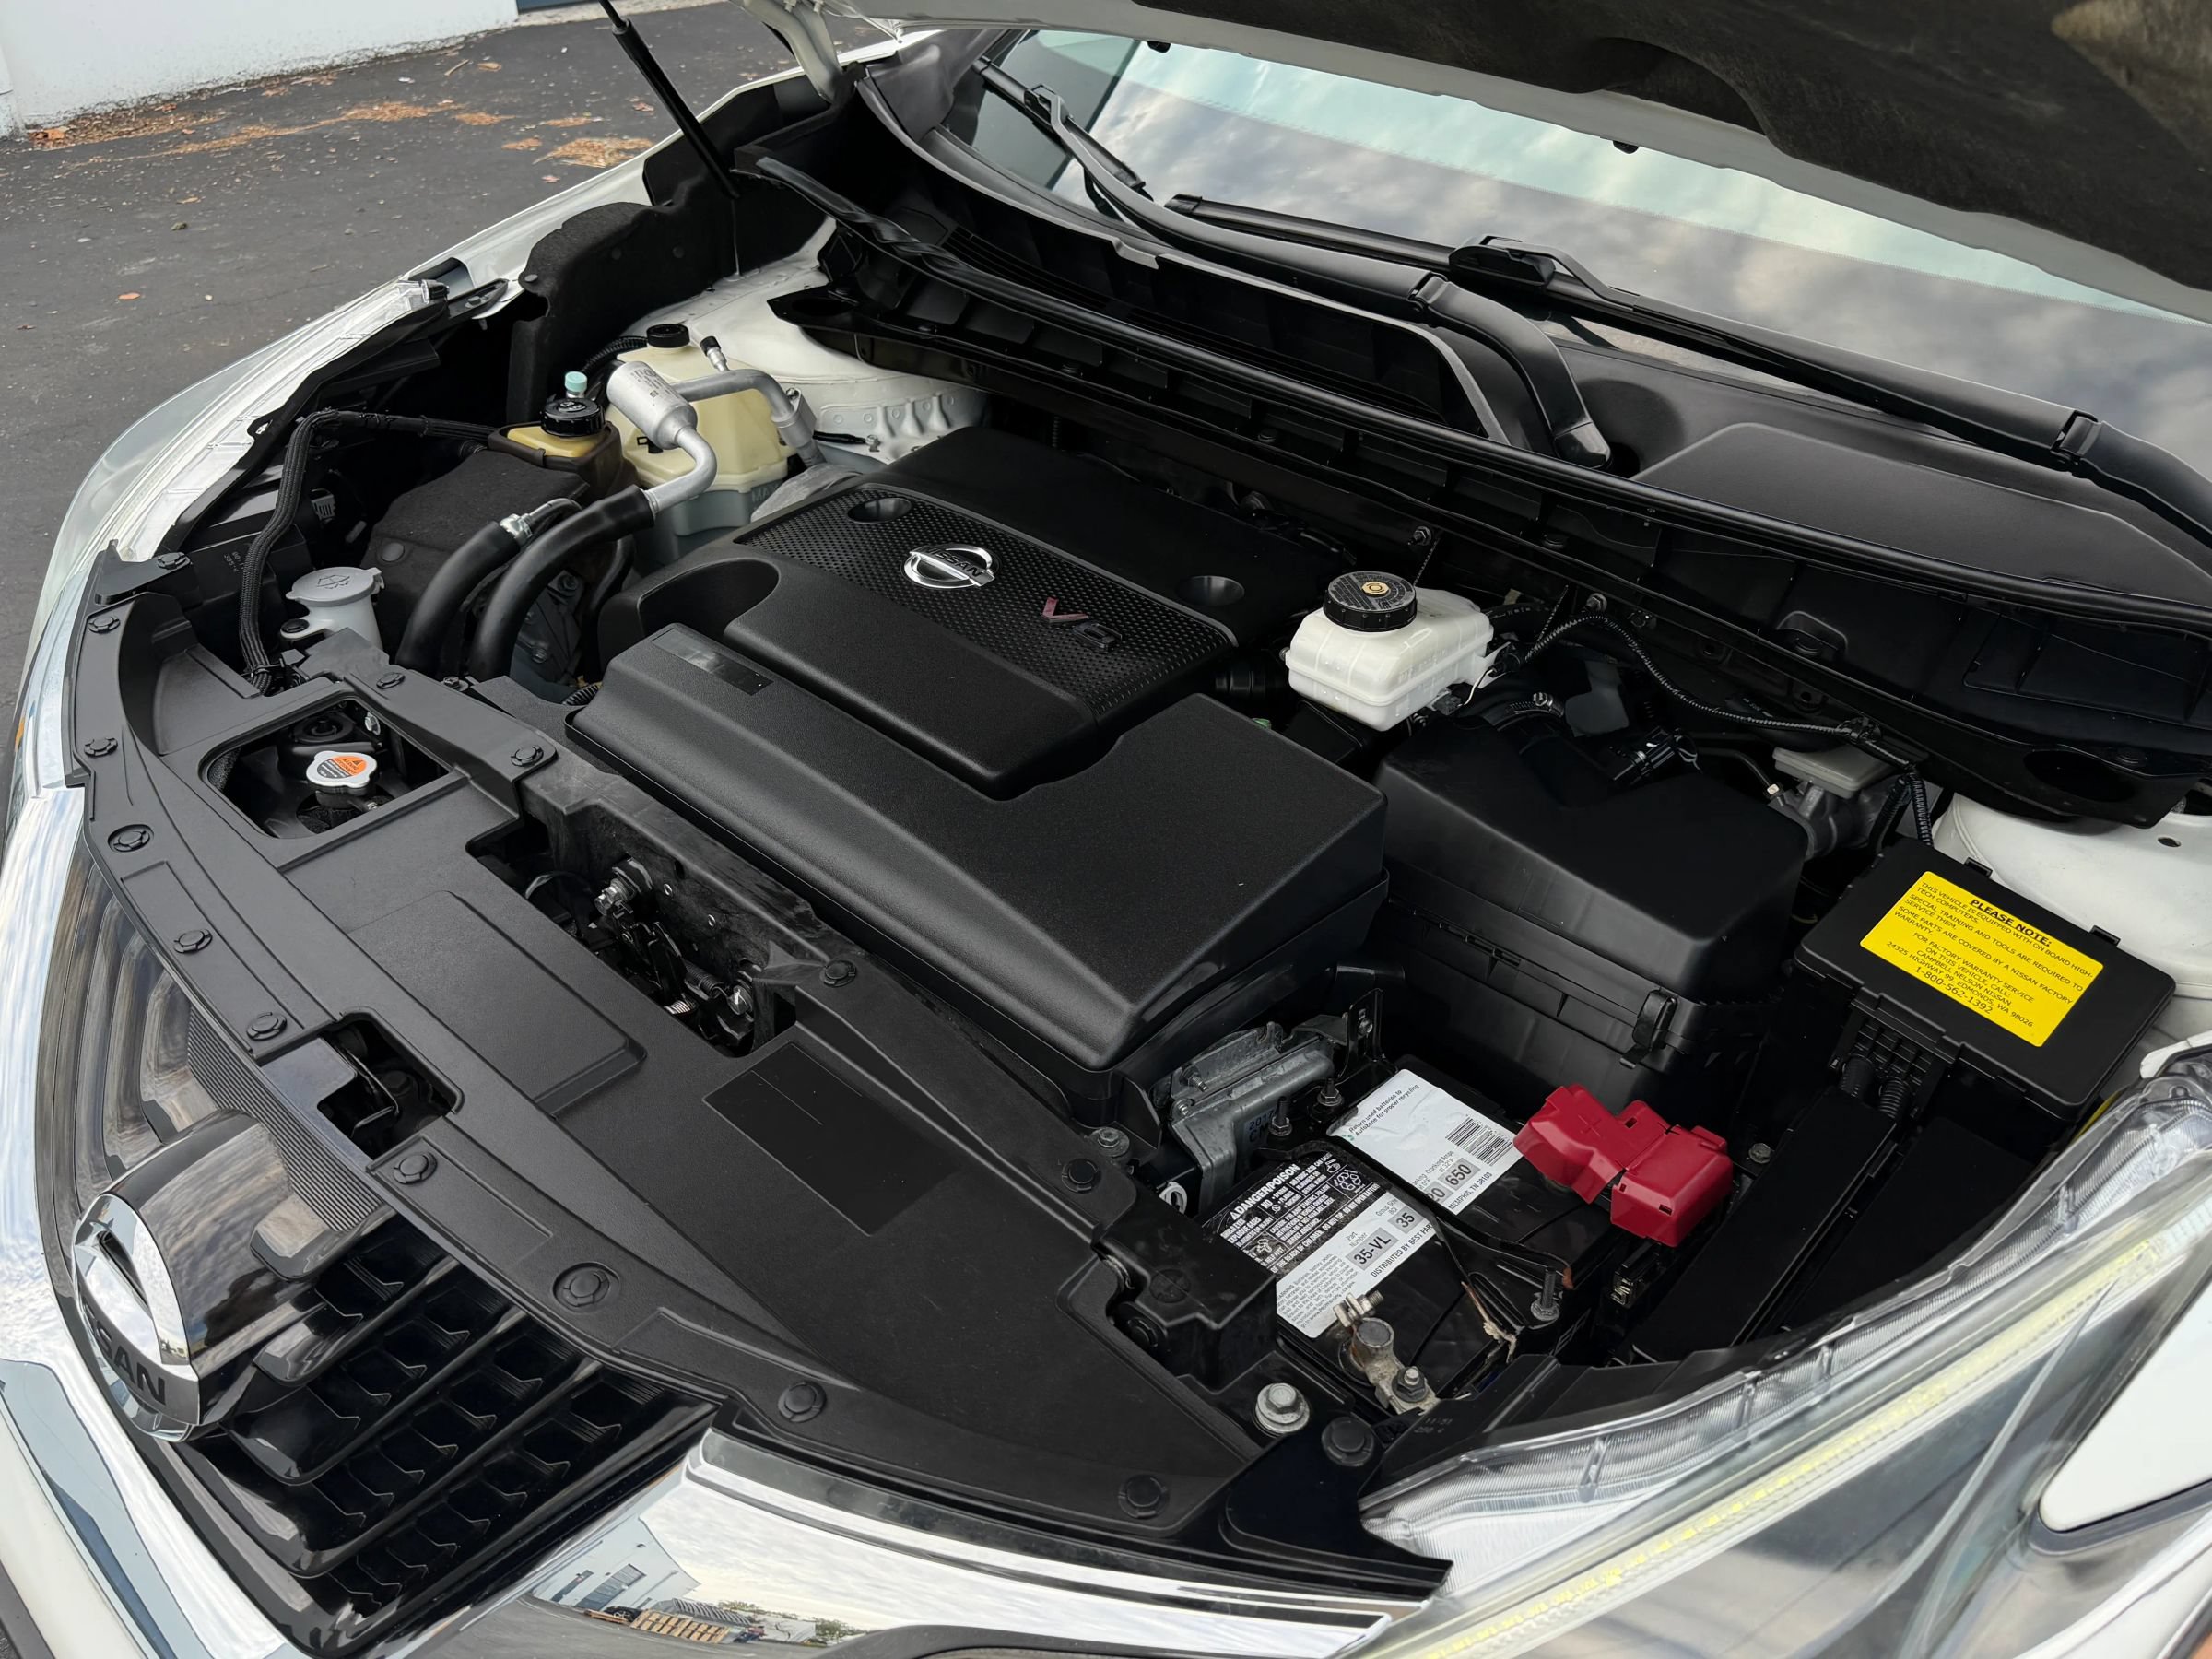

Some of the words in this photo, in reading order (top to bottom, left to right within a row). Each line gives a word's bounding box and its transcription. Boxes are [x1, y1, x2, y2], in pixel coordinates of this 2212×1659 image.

[1893, 910, 1934, 935] WARRANTY.
[1904, 898, 1936, 917] SERVICE
[1935, 914, 1958, 930] THEM.
[1916, 887, 1936, 900] TECH
[1935, 897, 1980, 924] COMPUTERS.
[1920, 881, 1938, 894] THIS
[1936, 890, 1968, 910] VEHICLE
[1966, 906, 1977, 914] IS
[1975, 912, 2012, 934] EQUIPPED
[2010, 931, 2033, 945] WITH
[2031, 942, 2045, 952] ON
[2043, 948, 2071, 966] BOARD
[1969, 898, 2014, 925] PLEASE
[2014, 923, 2053, 947] NOTE:
[1898, 904, 1920, 919] SOME
[1919, 916, 1943, 932] PARTS
[1941, 929, 1958, 940] ARE
[1957, 937, 1993, 959] COVERED
[1991, 957, 2003, 966] BY
[2009, 967, 2039, 985] NISSAN
[2038, 982, 2073, 1005] FACTORY
[1909, 893, 1939, 912] SPECIAL
[1938, 909, 1974, 931] TRAINING
[1973, 928, 1991, 941] AND
[1991, 938, 2017, 955] TOOLS
[2015, 951, 2032, 964] ARE
[2031, 960, 2071, 985] REQUIRED
[2070, 982, 2084, 992] TO
[1886, 939, 1910, 955] 24325
[1908, 952, 1944, 975] HIGHWAY
[1943, 972, 1957, 982] 99,
[1956, 980, 1996, 1006] EDMONDS,
[1995, 1003, 2010, 1014] WA
[2009, 1011, 2034, 1028] 98026
[1912, 931, 1929, 943] FOR
[1927, 940, 1961, 961] FACTORY
[1960, 959, 2003, 985] WARRANTY
[2001, 982, 2035, 1003] SERVICE
[1913, 965, 1994, 1015] 1-800-562-1392
[1915, 948, 1954, 973] CAMPBELL
[1952, 970, 1983, 990] NELSON
[1983, 987, 2012, 1006] NISSAN
[1924, 946, 1938, 957] ON
[1937, 953, 1957, 967] THIS
[1956, 964, 1990, 985] VEHICLE,
[1989, 982, 2011, 998] CALL:
[1364, 1109, 1378, 1120] used
[1234, 1161, 1300, 1216] DANGER/POISON
[1425, 1185, 1446, 1203] 20
[1442, 1162, 1473, 1187] 650
[1447, 1188, 1474, 1210] MEMPHIS,
[1469, 1182, 1479, 1191] TN
[1260, 1198, 1274, 1209] NO
[1394, 1211, 1416, 1229] 35
[1352, 1231, 1392, 1265] 35-VL
[1370, 1248, 1404, 1277] DISTRIBUTED
[1400, 1242, 1411, 1252] BY
[1407, 1231, 1423, 1245] BEST
